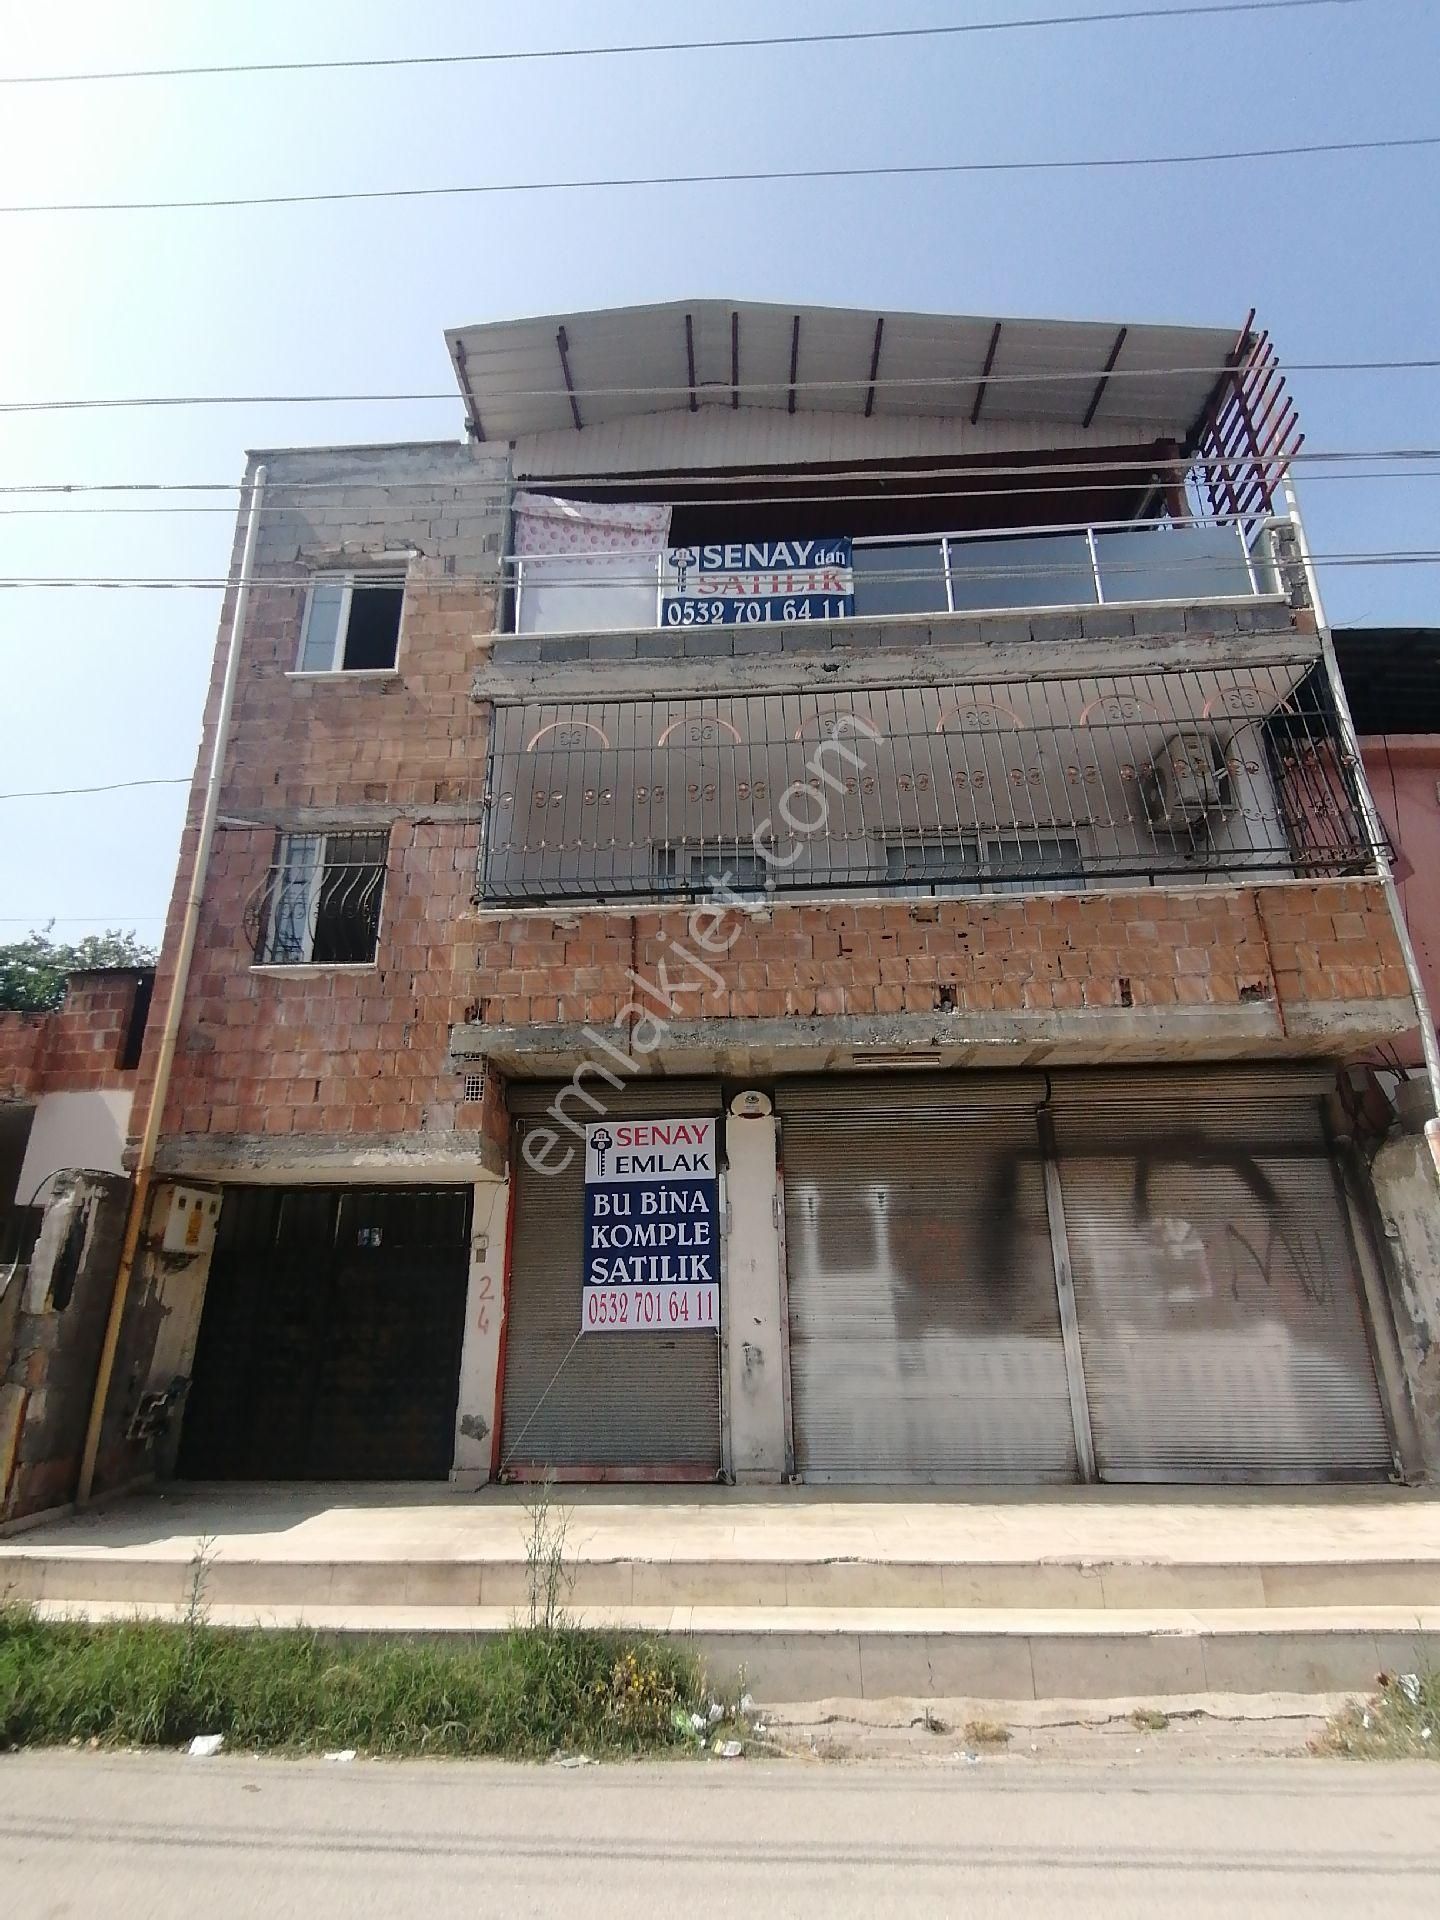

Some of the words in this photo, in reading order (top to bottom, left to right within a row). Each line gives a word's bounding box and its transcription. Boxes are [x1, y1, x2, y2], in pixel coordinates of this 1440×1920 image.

[697, 571, 846, 595] SATILIK
[667, 601, 724, 625] 0532
[733, 601, 771, 623] 701
[783, 599, 811, 622] 64
[823, 600, 845, 619] 11
[616, 1124, 709, 1147] SENAY
[616, 1153, 710, 1174] EMLAK
[593, 1193, 631, 1216] BU
[640, 1186, 709, 1215] BİNA
[591, 1222, 711, 1249] KOMPLE
[589, 1254, 712, 1284] SATILIK
[588, 1292, 628, 1324] 0532
[634, 1291, 662, 1322] 701
[669, 1291, 689, 1322] 64
[697, 1290, 713, 1321] 11
